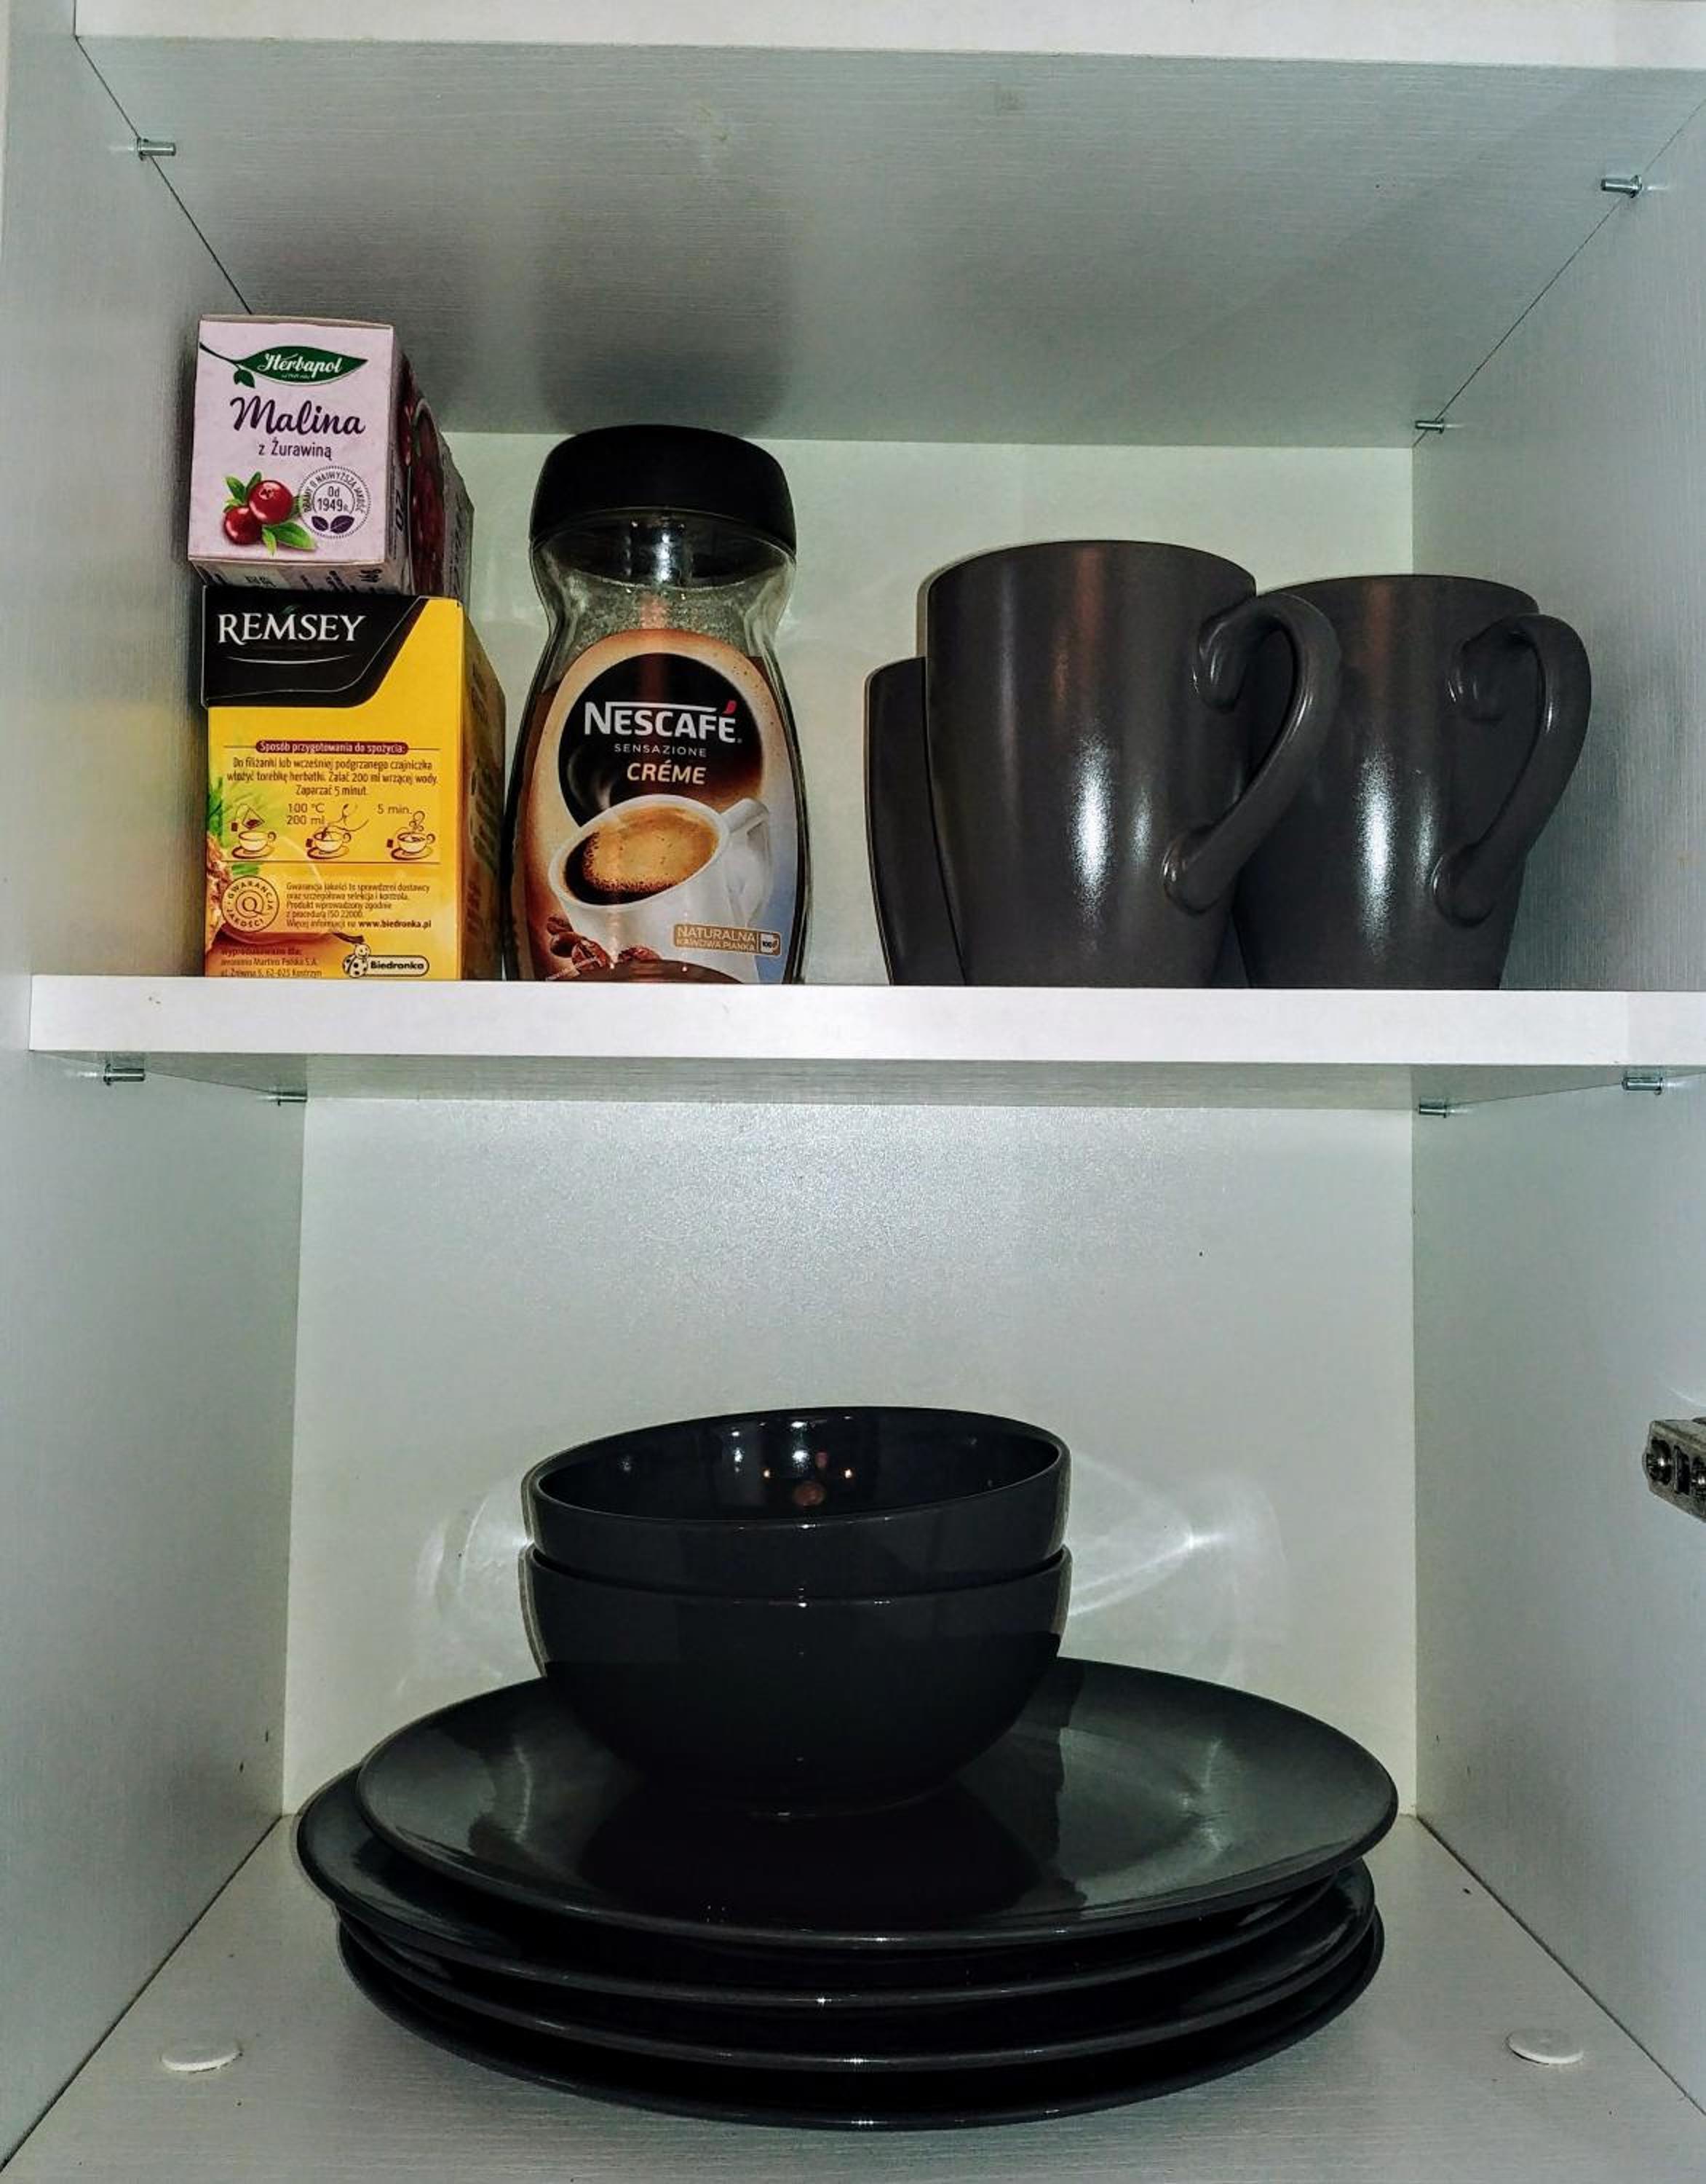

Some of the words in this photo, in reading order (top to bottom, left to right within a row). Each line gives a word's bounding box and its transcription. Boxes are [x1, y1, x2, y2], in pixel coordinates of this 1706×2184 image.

[257, 353, 343, 379] Herbapol
[229, 395, 366, 435] Malina
[258, 445, 265, 456] z
[271, 437, 332, 461] Żurawiną
[218, 613, 366, 646] REMSEY
[584, 700, 738, 744] NESCAFÉ
[260, 742, 290, 753] Sposób
[292, 743, 353, 754] przygotowania
[614, 743, 707, 758] SENSAZIONE
[336, 759, 389, 772] podgrzanego
[352, 773, 369, 783] 200
[627, 760, 707, 785] CRÉME
[334, 786, 341, 797] 5
[287, 803, 308, 813] 100
[377, 803, 384, 815] 5
[286, 815, 307, 825] 200
[311, 815, 326, 825] ml
[358, 919, 432, 930] www.biedronka.pl
[677, 925, 756, 945] NATURALNA
[370, 960, 424, 970] Biedronka
